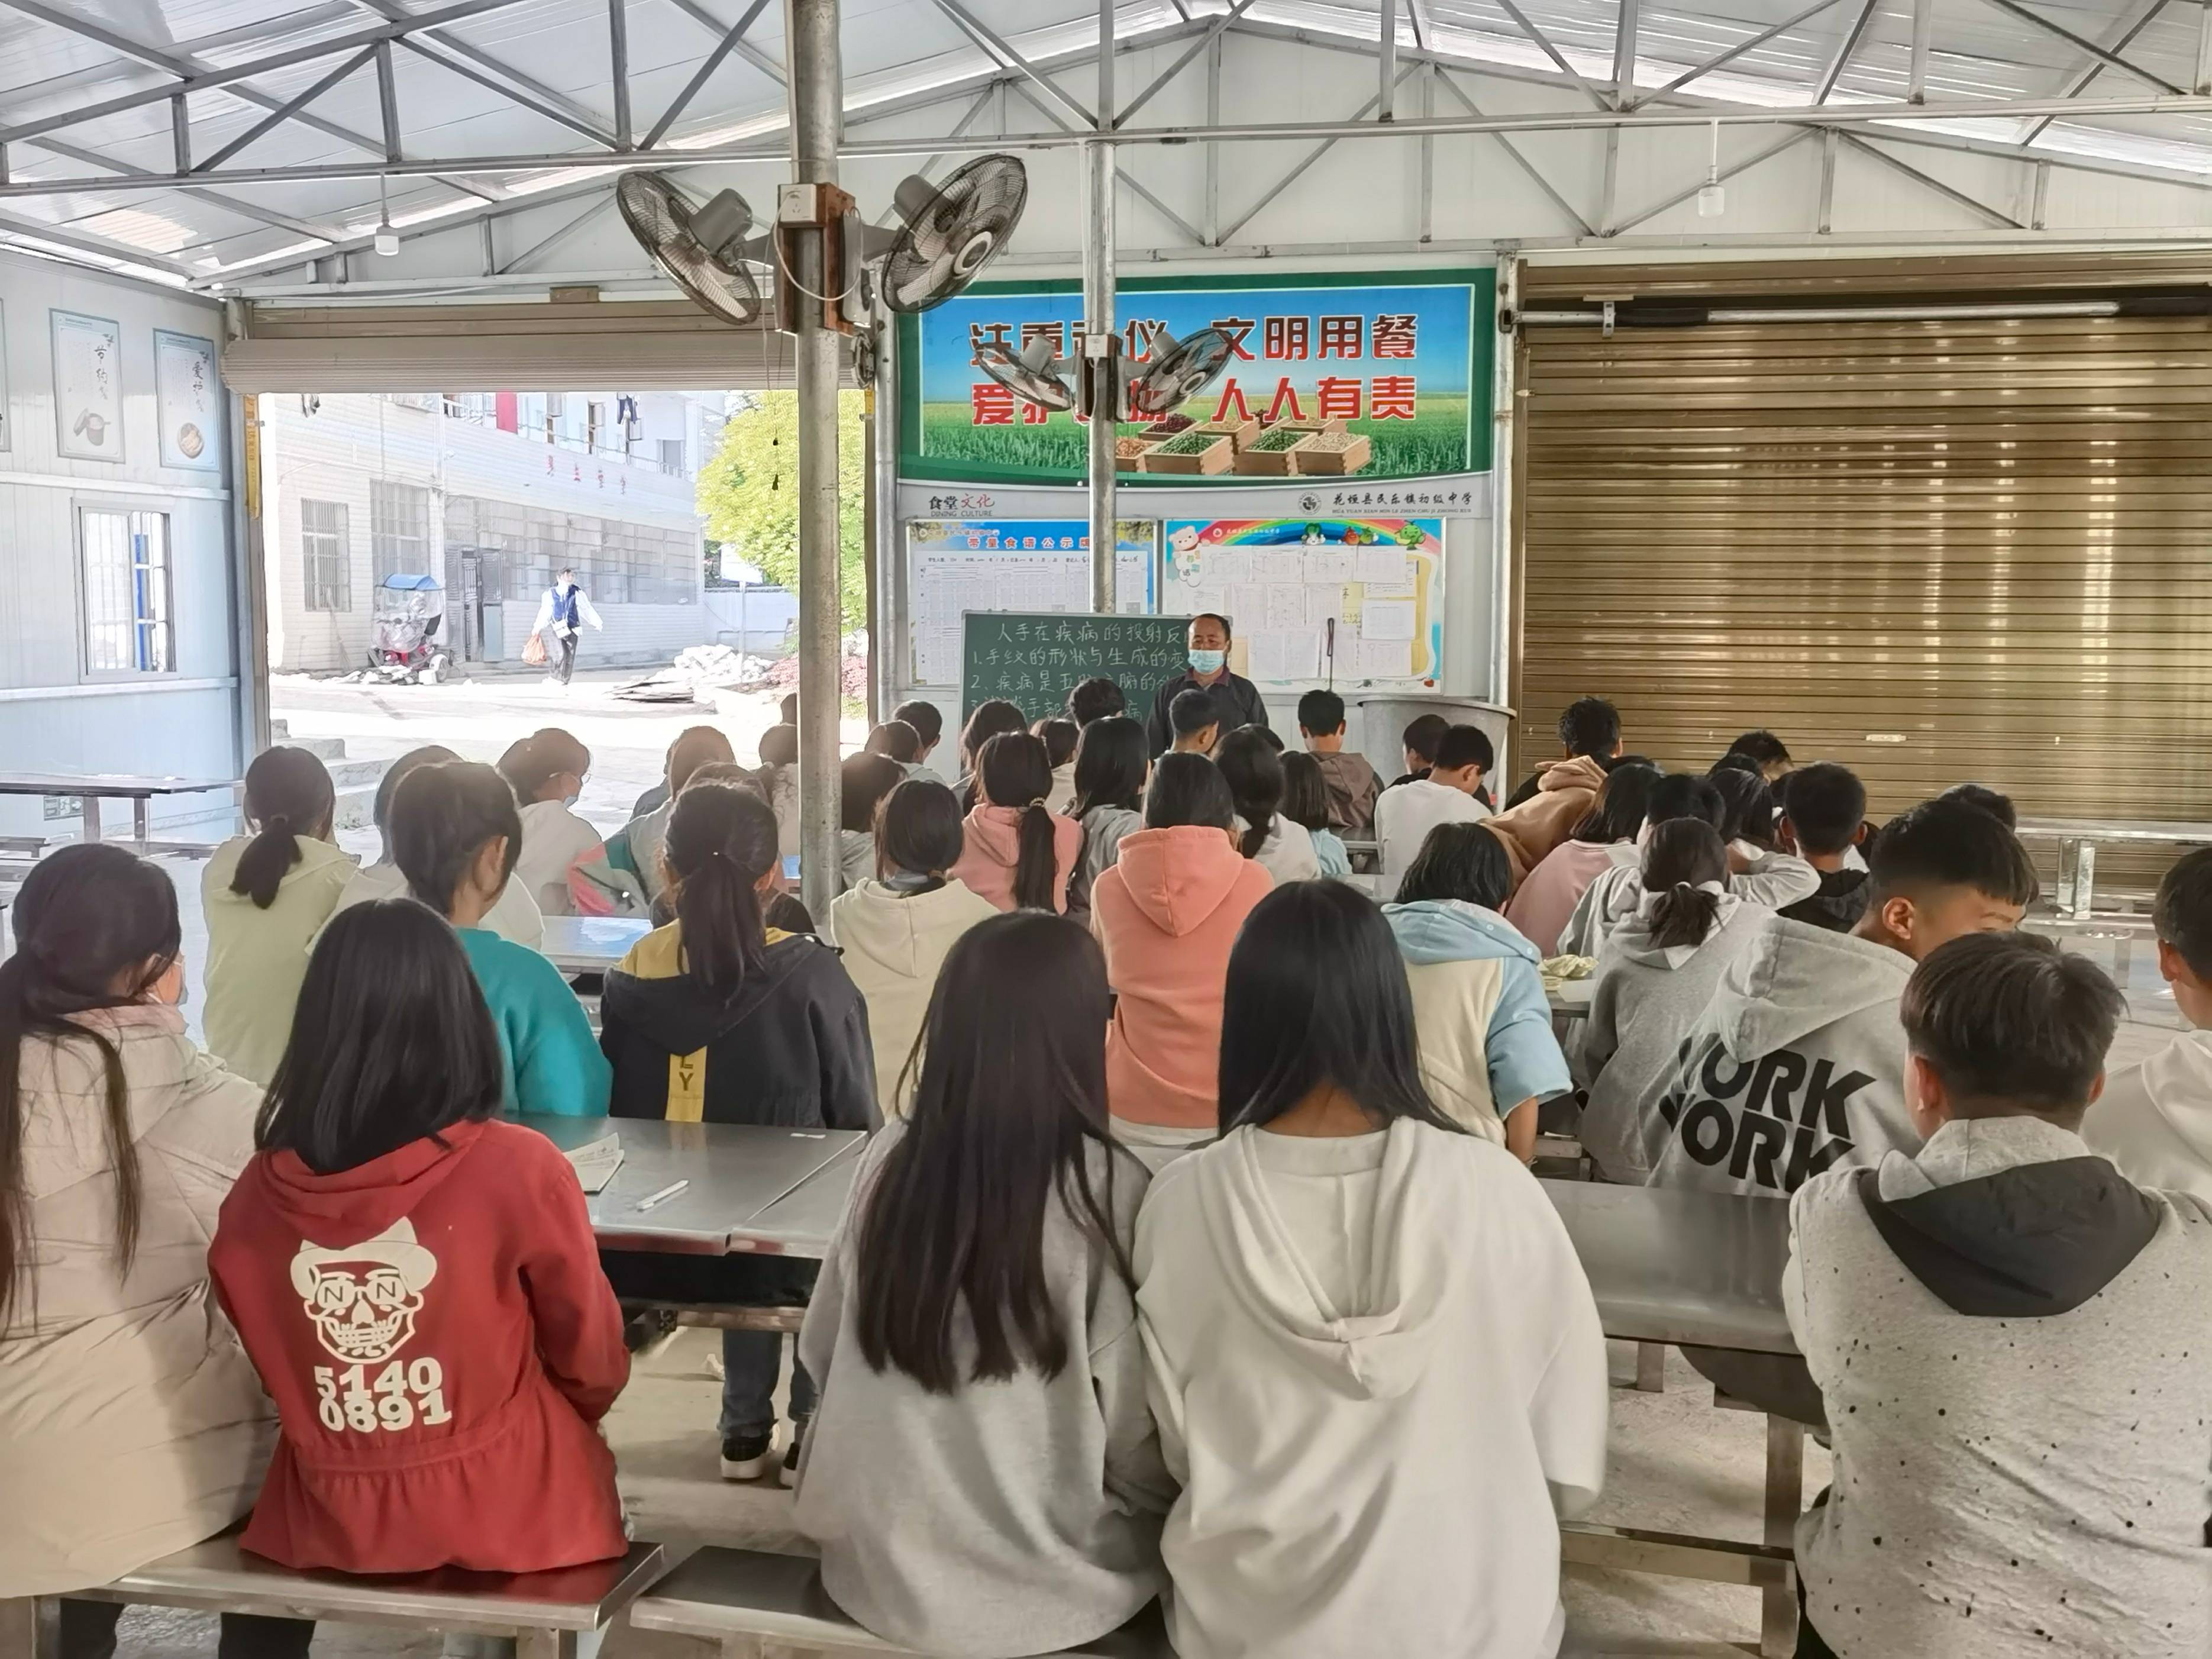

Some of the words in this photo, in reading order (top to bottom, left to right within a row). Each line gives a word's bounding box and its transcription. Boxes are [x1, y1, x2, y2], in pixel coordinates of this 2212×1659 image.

[1211, 314, 1418, 362] 文明用餐
[1211, 376, 1417, 423] 人人有责
[997, 620, 1188, 644] 人手在疾病的投射反
[314, 1357, 443, 1400] 5140
[319, 1389, 453, 1433] 0891
